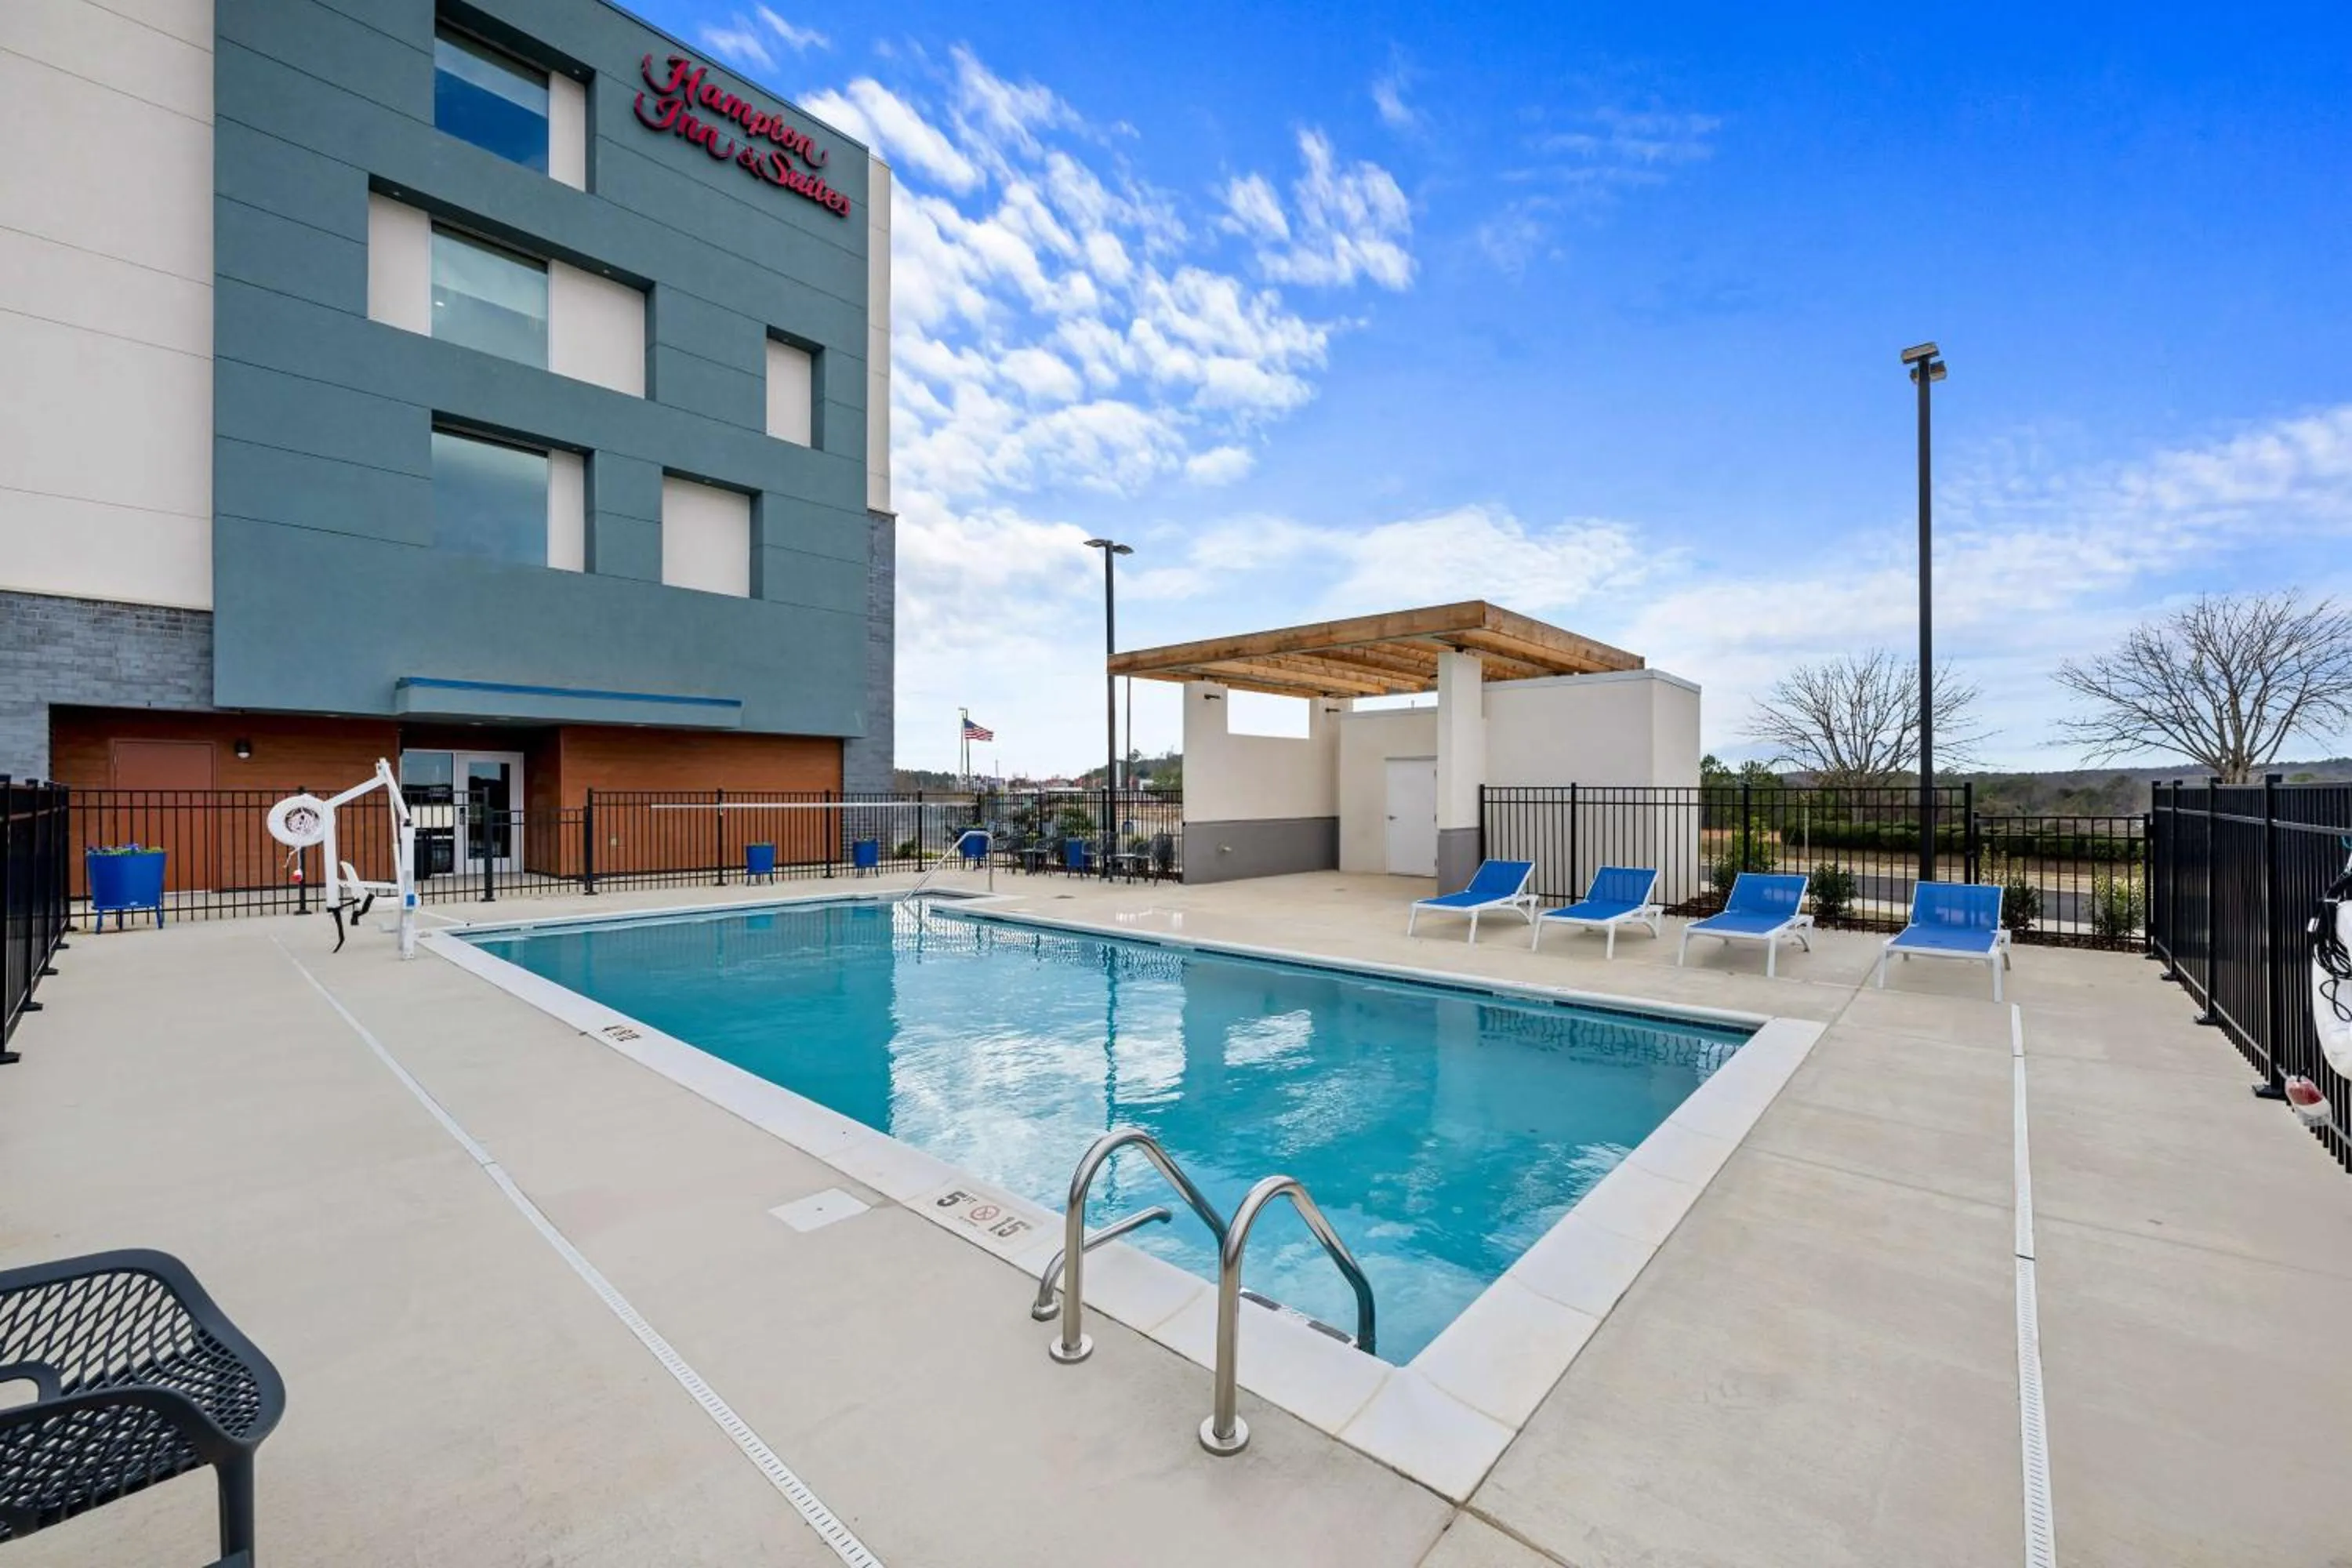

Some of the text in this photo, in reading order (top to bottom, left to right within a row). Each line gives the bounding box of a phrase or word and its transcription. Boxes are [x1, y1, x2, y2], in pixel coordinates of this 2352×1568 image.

[633, 90, 851, 217] Inn & Suites
[642, 53, 829, 168] Hampton
